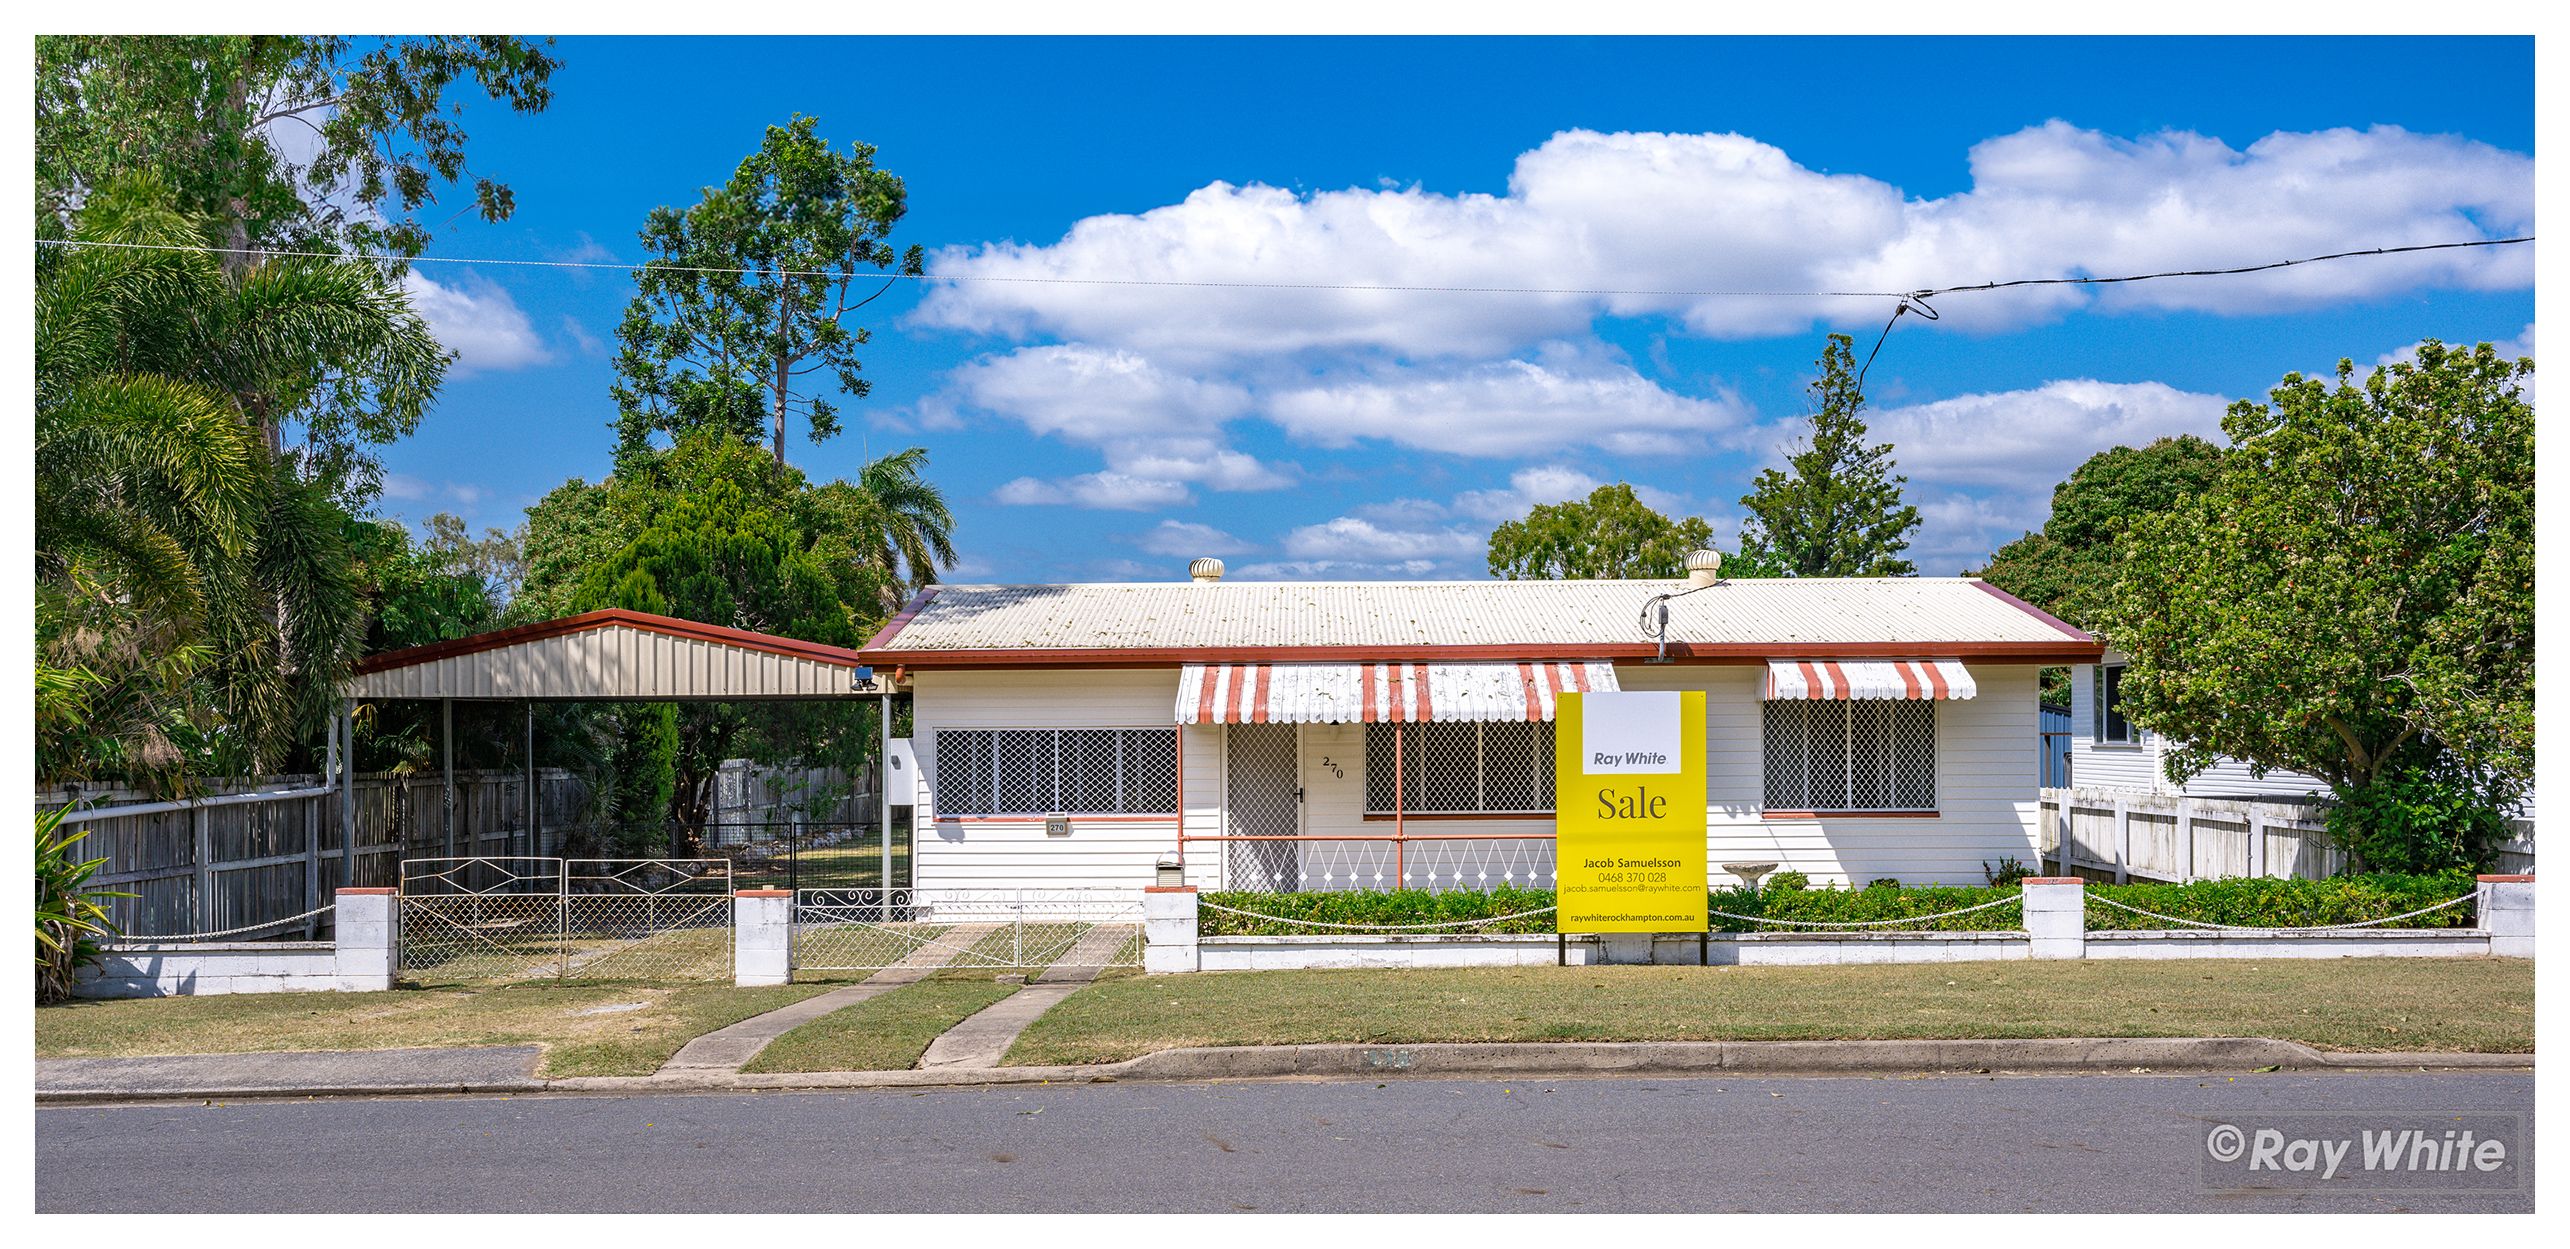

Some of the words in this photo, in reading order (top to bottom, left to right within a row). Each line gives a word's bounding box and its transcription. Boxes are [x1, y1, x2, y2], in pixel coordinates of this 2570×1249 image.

[1594, 752, 1623, 767] Ray
[1625, 752, 1667, 765] White
[1322, 756, 1344, 779] 270
[1598, 786, 1667, 819] Sale
[1050, 824, 1064, 832] 270
[1583, 858, 1615, 868] Jacob
[1617, 858, 1681, 868] Samuelsson
[1598, 872, 1624, 883] 0468
[1626, 872, 1645, 883] 370
[1647, 872, 1667, 883] 028
[1563, 884, 1701, 894] jacob.samuelsson@raywhite.com
[1570, 913, 1695, 923] raywhiterockhampton.com.au
